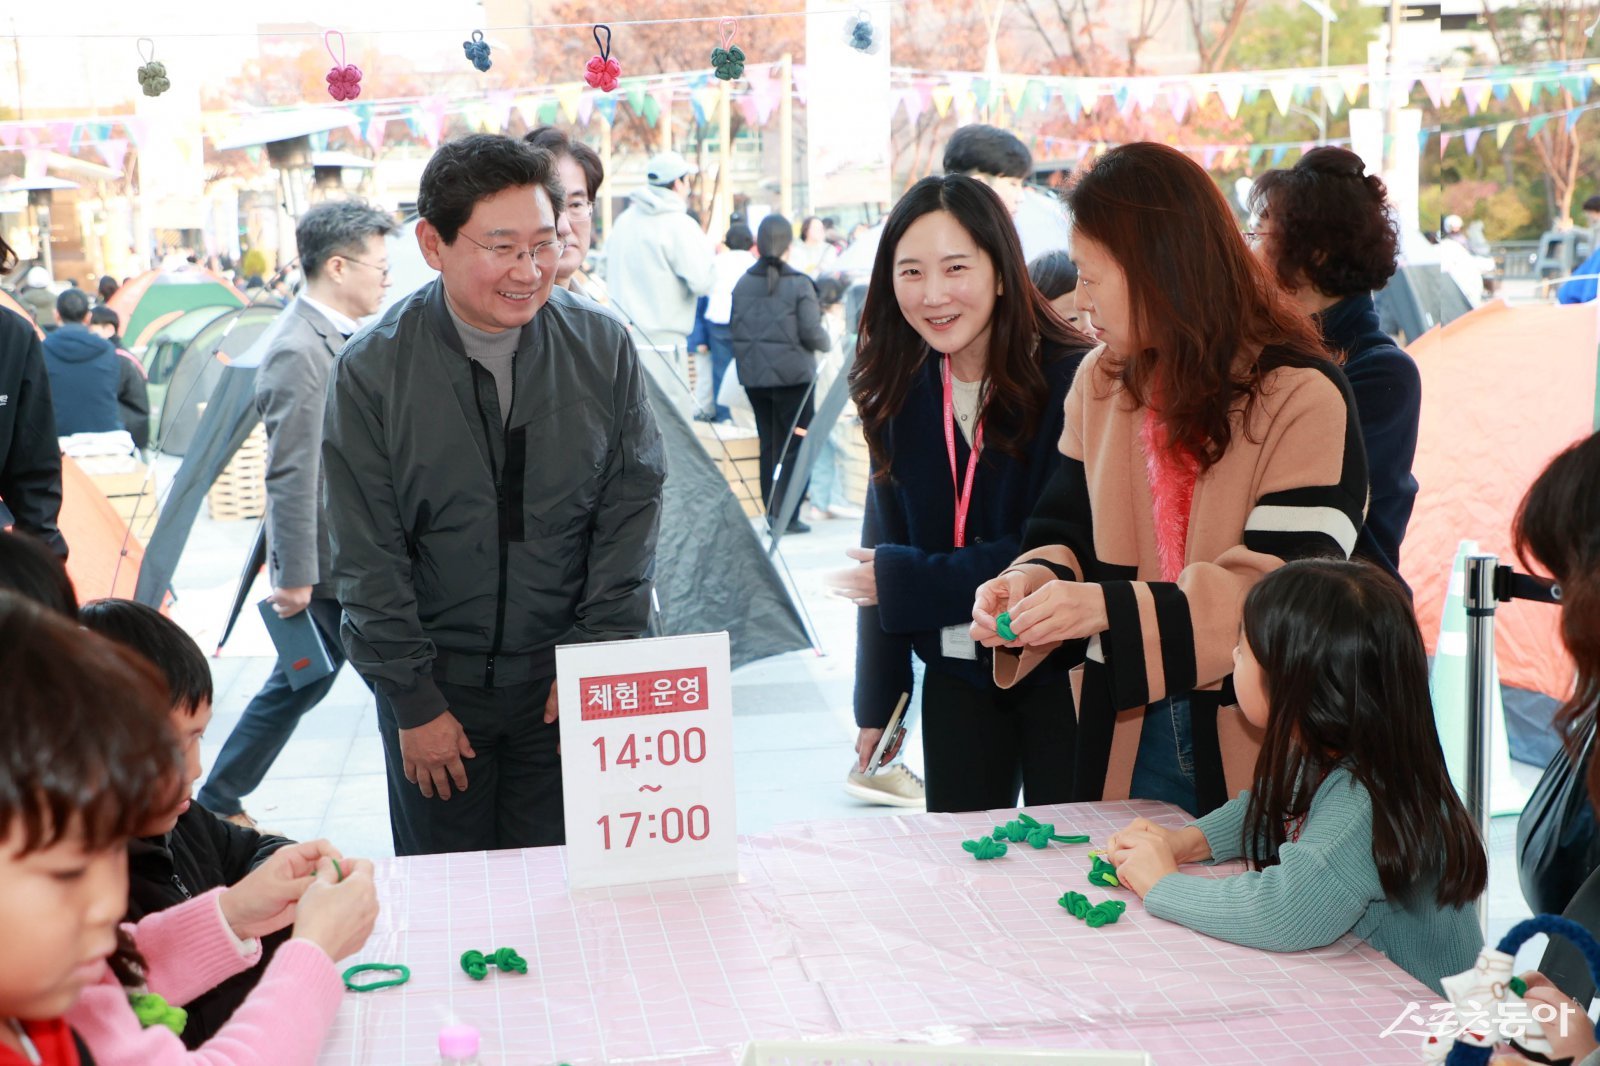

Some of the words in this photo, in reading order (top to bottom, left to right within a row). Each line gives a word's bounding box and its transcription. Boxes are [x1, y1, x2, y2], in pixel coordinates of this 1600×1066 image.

[587, 681, 638, 711] 체험
[650, 675, 700, 707] 운영
[592, 727, 706, 772] 14:00
[596, 804, 710, 850] 17:00
